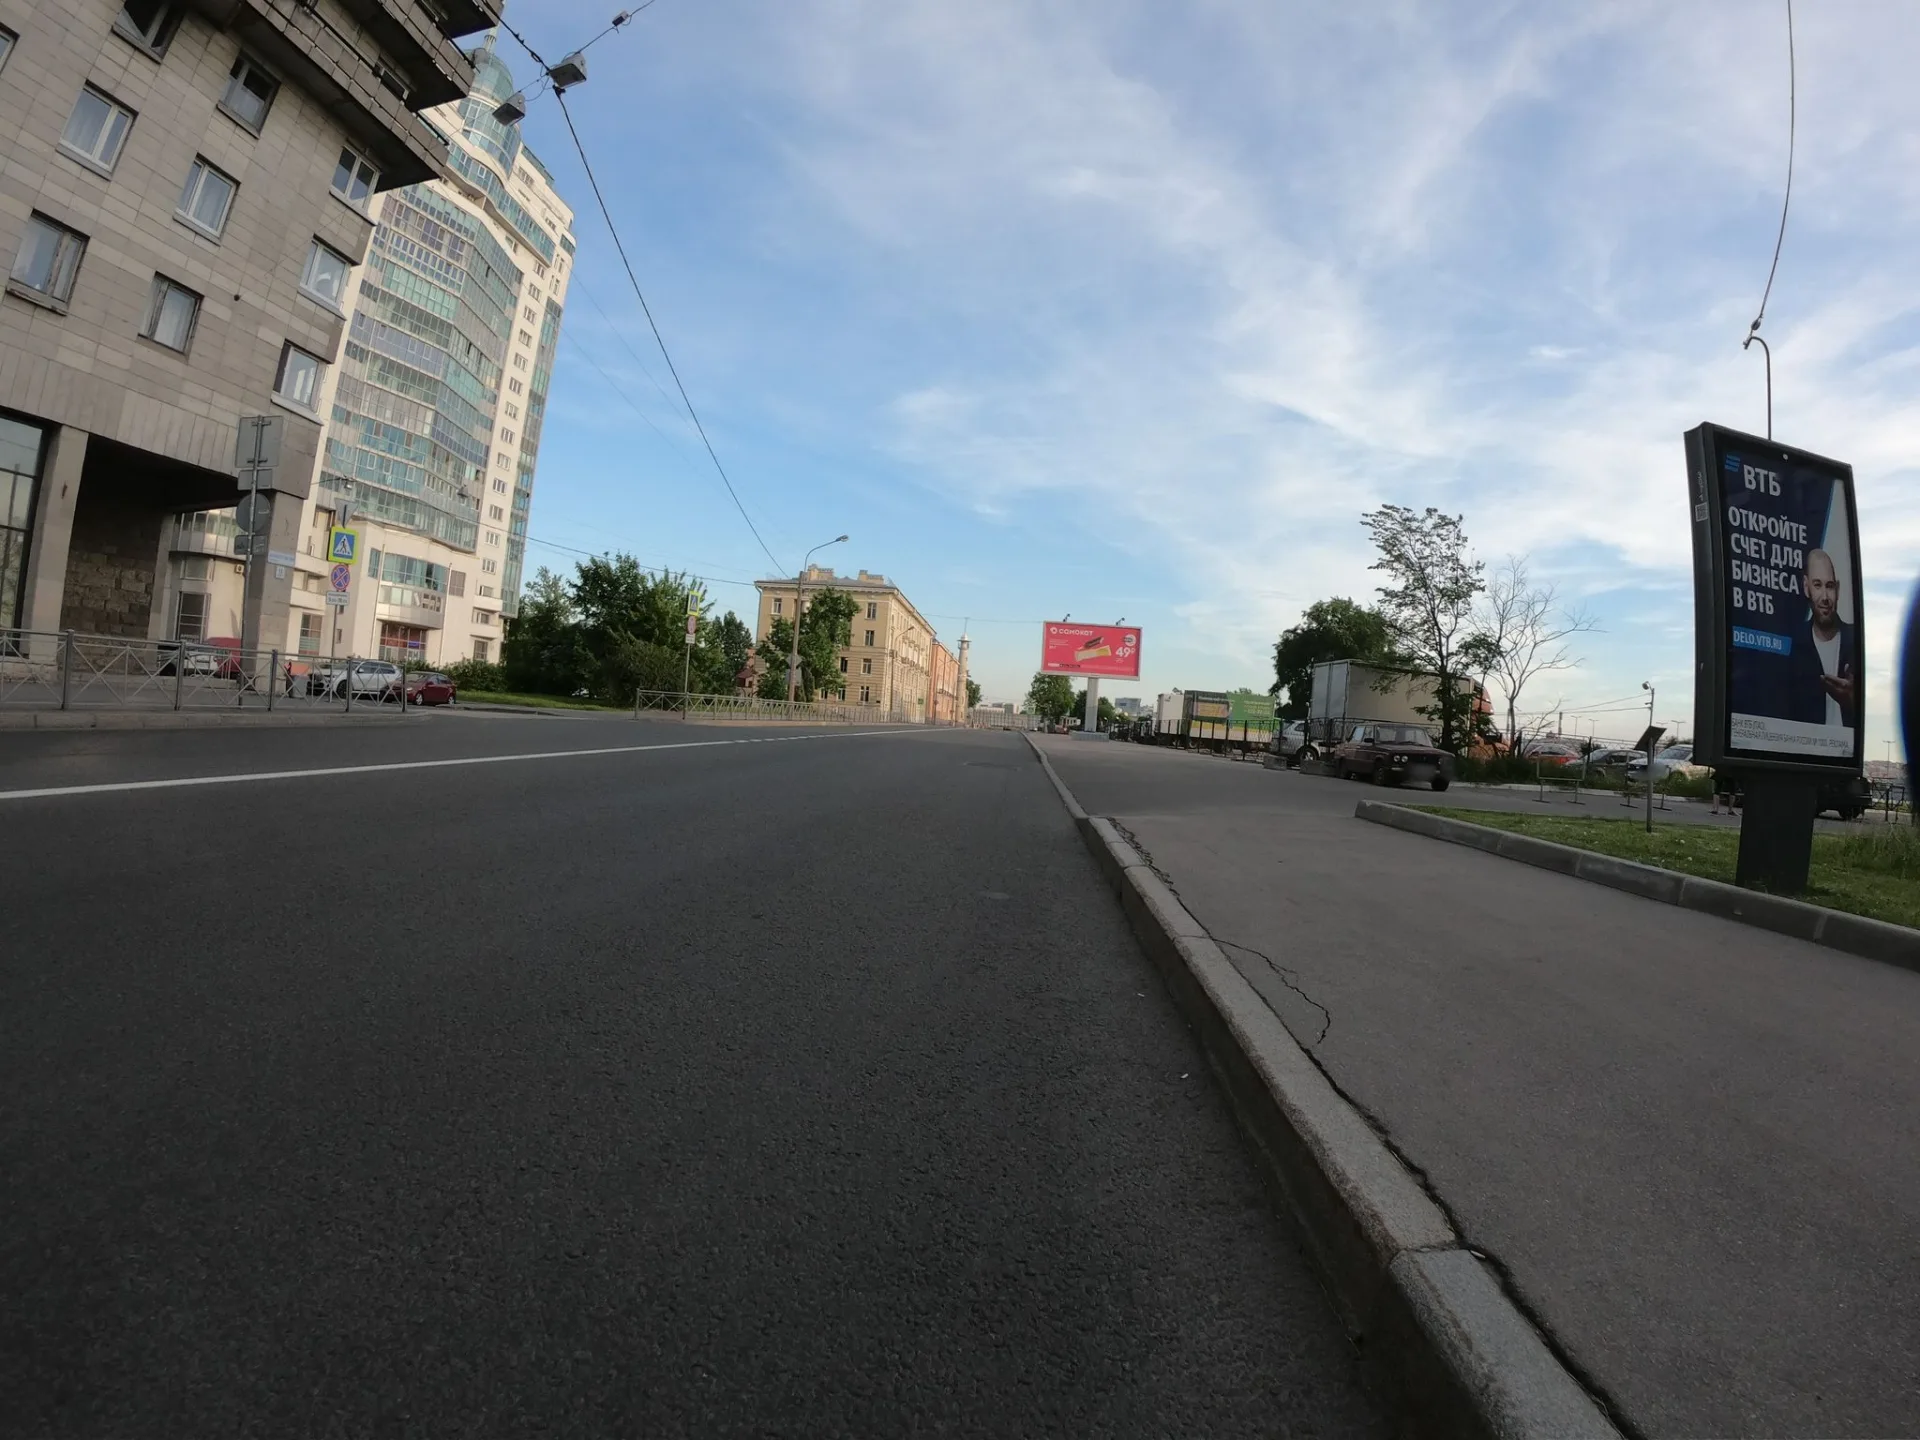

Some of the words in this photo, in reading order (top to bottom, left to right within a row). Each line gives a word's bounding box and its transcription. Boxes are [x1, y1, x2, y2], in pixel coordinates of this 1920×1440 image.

[1743, 464, 1781, 497] ВТБ
[1728, 506, 1807, 545] ОТКРОЙТЕ
[1731, 532, 1766, 560] СЧЕТ
[1770, 543, 1803, 569] ДЛЯ
[1732, 559, 1799, 595] БИЗНЕСА
[1733, 586, 1744, 608] В
[1747, 590, 1774, 615] ВТБ
[1733, 630, 1782, 650] DELO.VTB.RU
